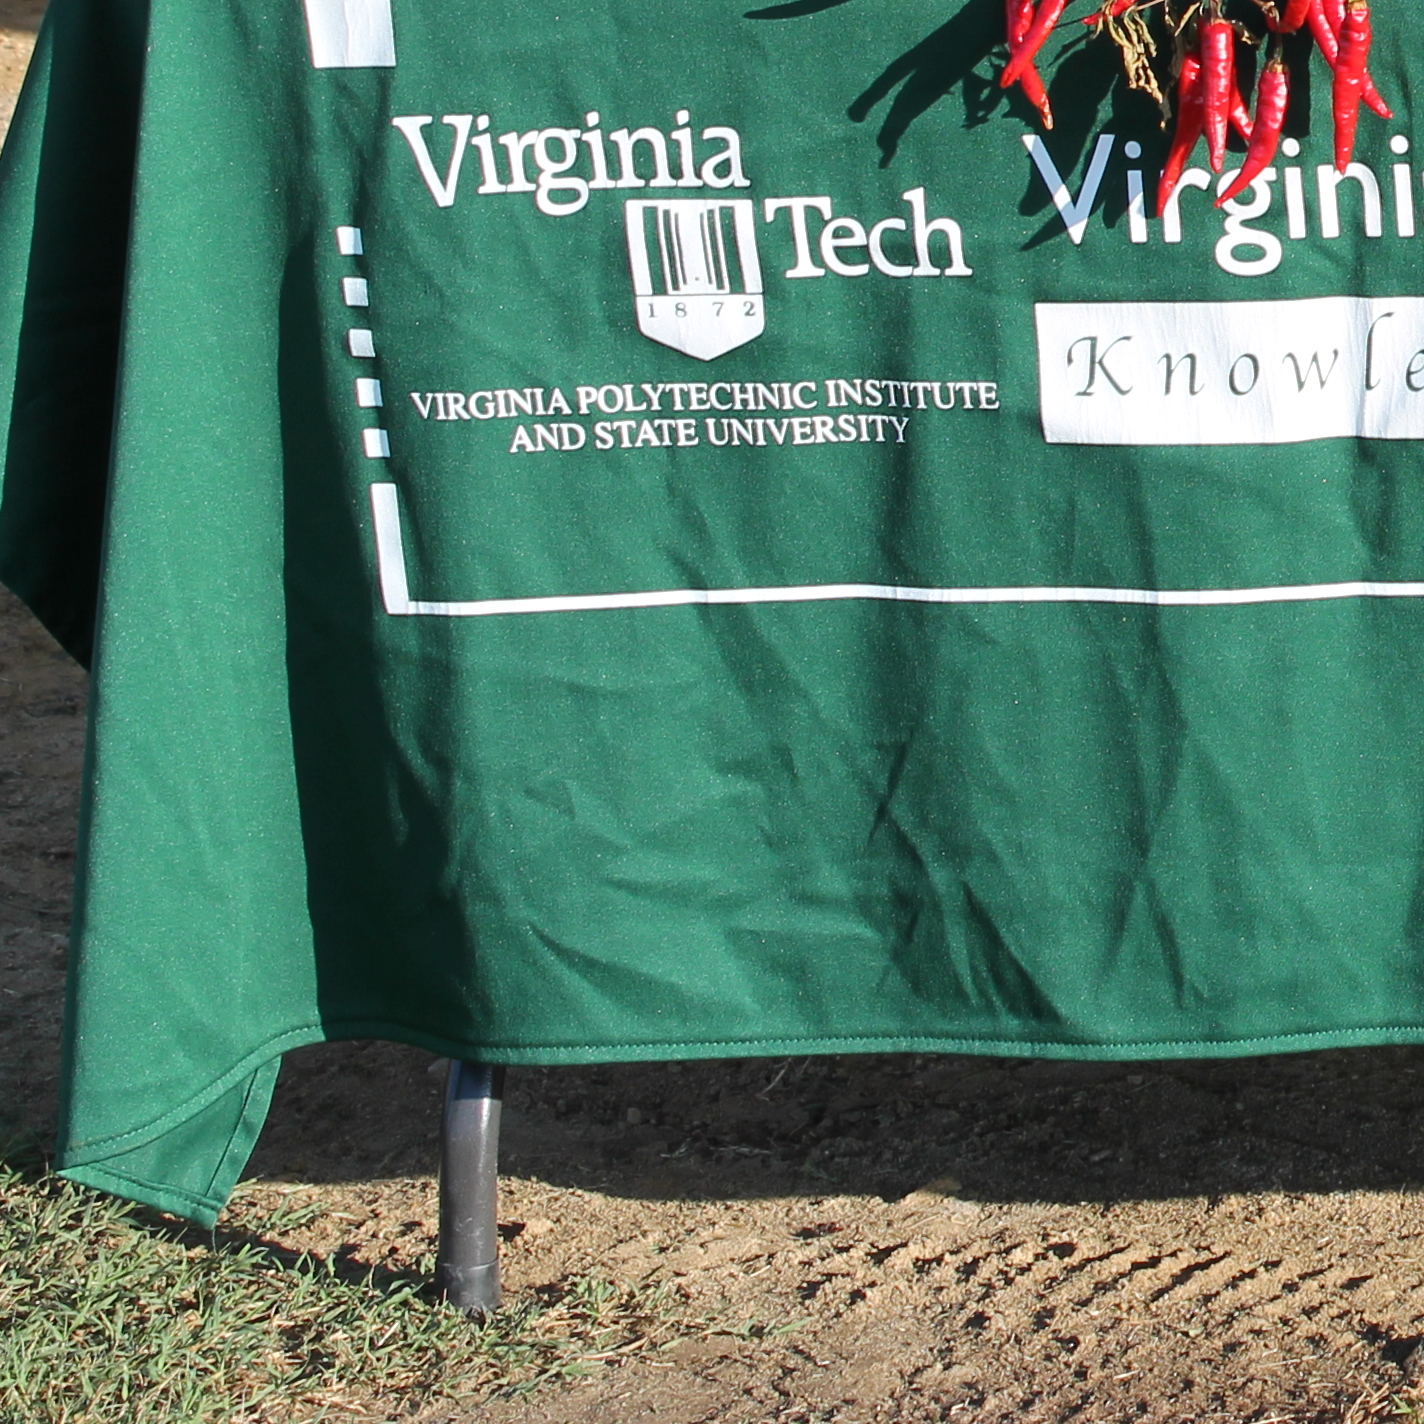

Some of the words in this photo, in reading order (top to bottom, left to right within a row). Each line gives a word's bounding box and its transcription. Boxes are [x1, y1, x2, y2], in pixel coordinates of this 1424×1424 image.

[391, 110, 751, 216] Virginia
[765, 187, 973, 279] Tech
[410, 388, 571, 423] VIRGINIA
[577, 381, 818, 417] POLYTECHNIC
[824, 379, 1000, 412] INSTITUTE
[509, 420, 586, 454] AND
[594, 417, 700, 450] STATE
[706, 413, 910, 447] UNIVERSITY
